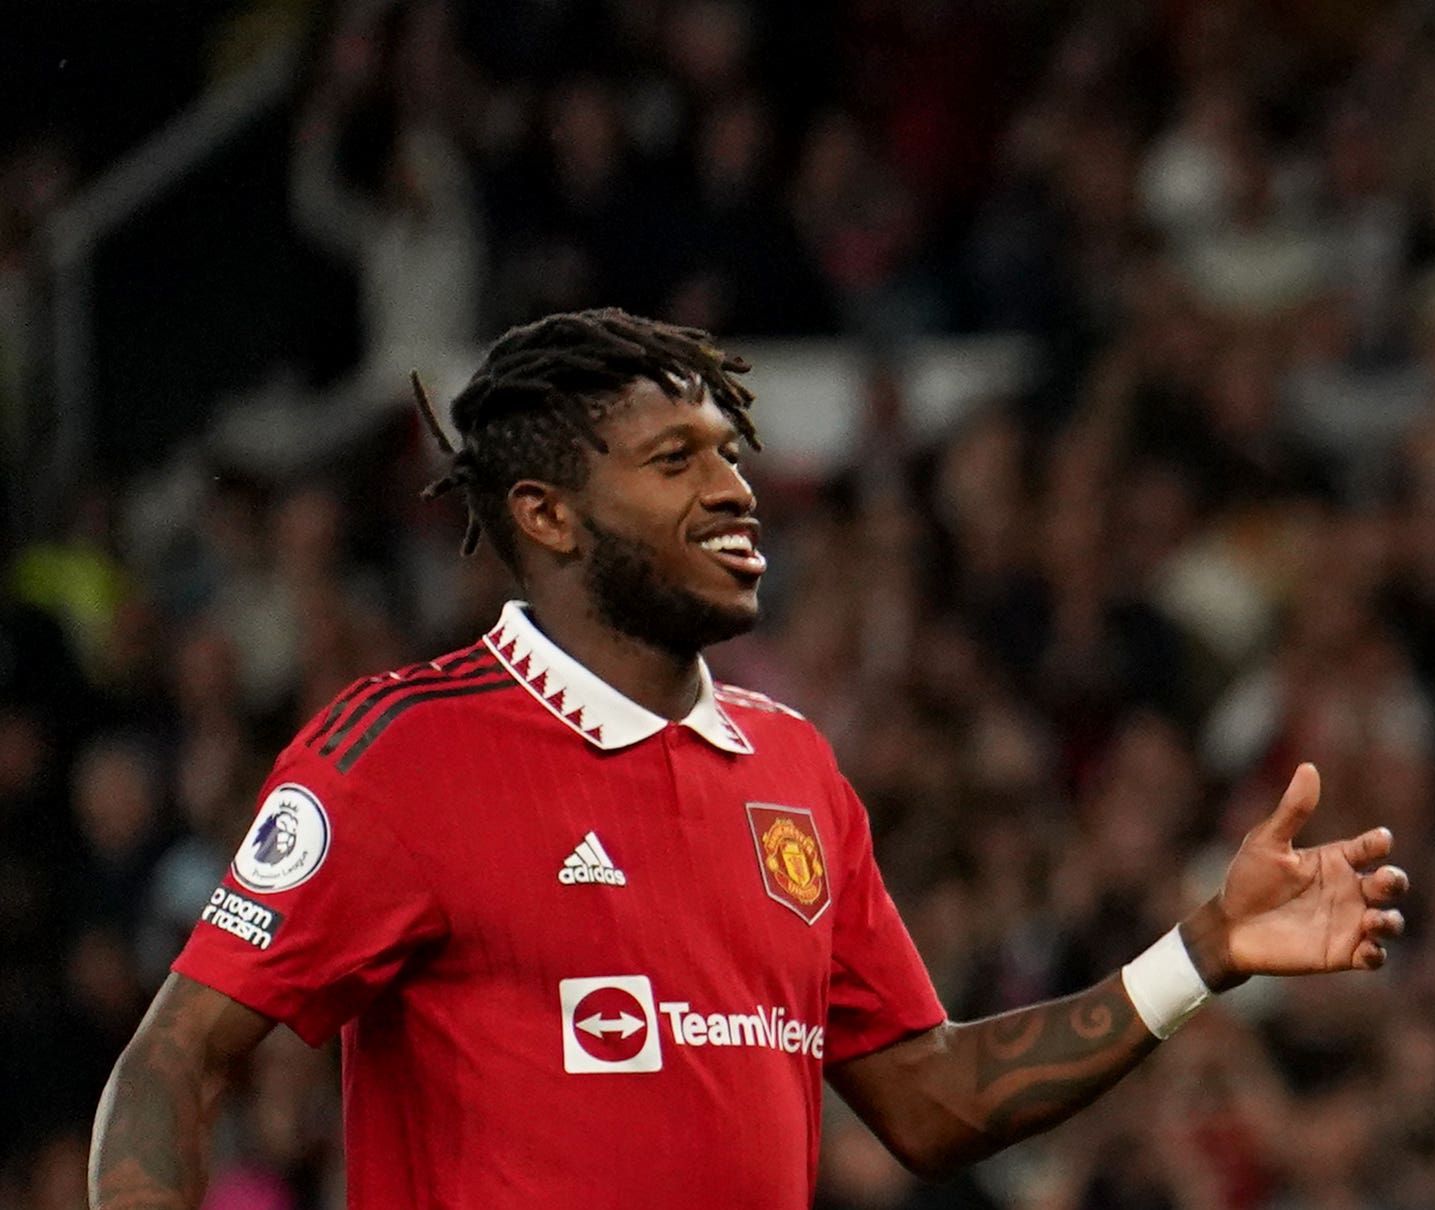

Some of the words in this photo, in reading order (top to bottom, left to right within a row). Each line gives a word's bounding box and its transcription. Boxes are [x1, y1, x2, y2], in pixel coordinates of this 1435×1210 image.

[558, 864, 627, 887] adidas
[210, 887, 226, 905] o
[222, 893, 273, 930] room
[210, 909, 273, 950] racism
[659, 1001, 824, 1060] TeamViee
